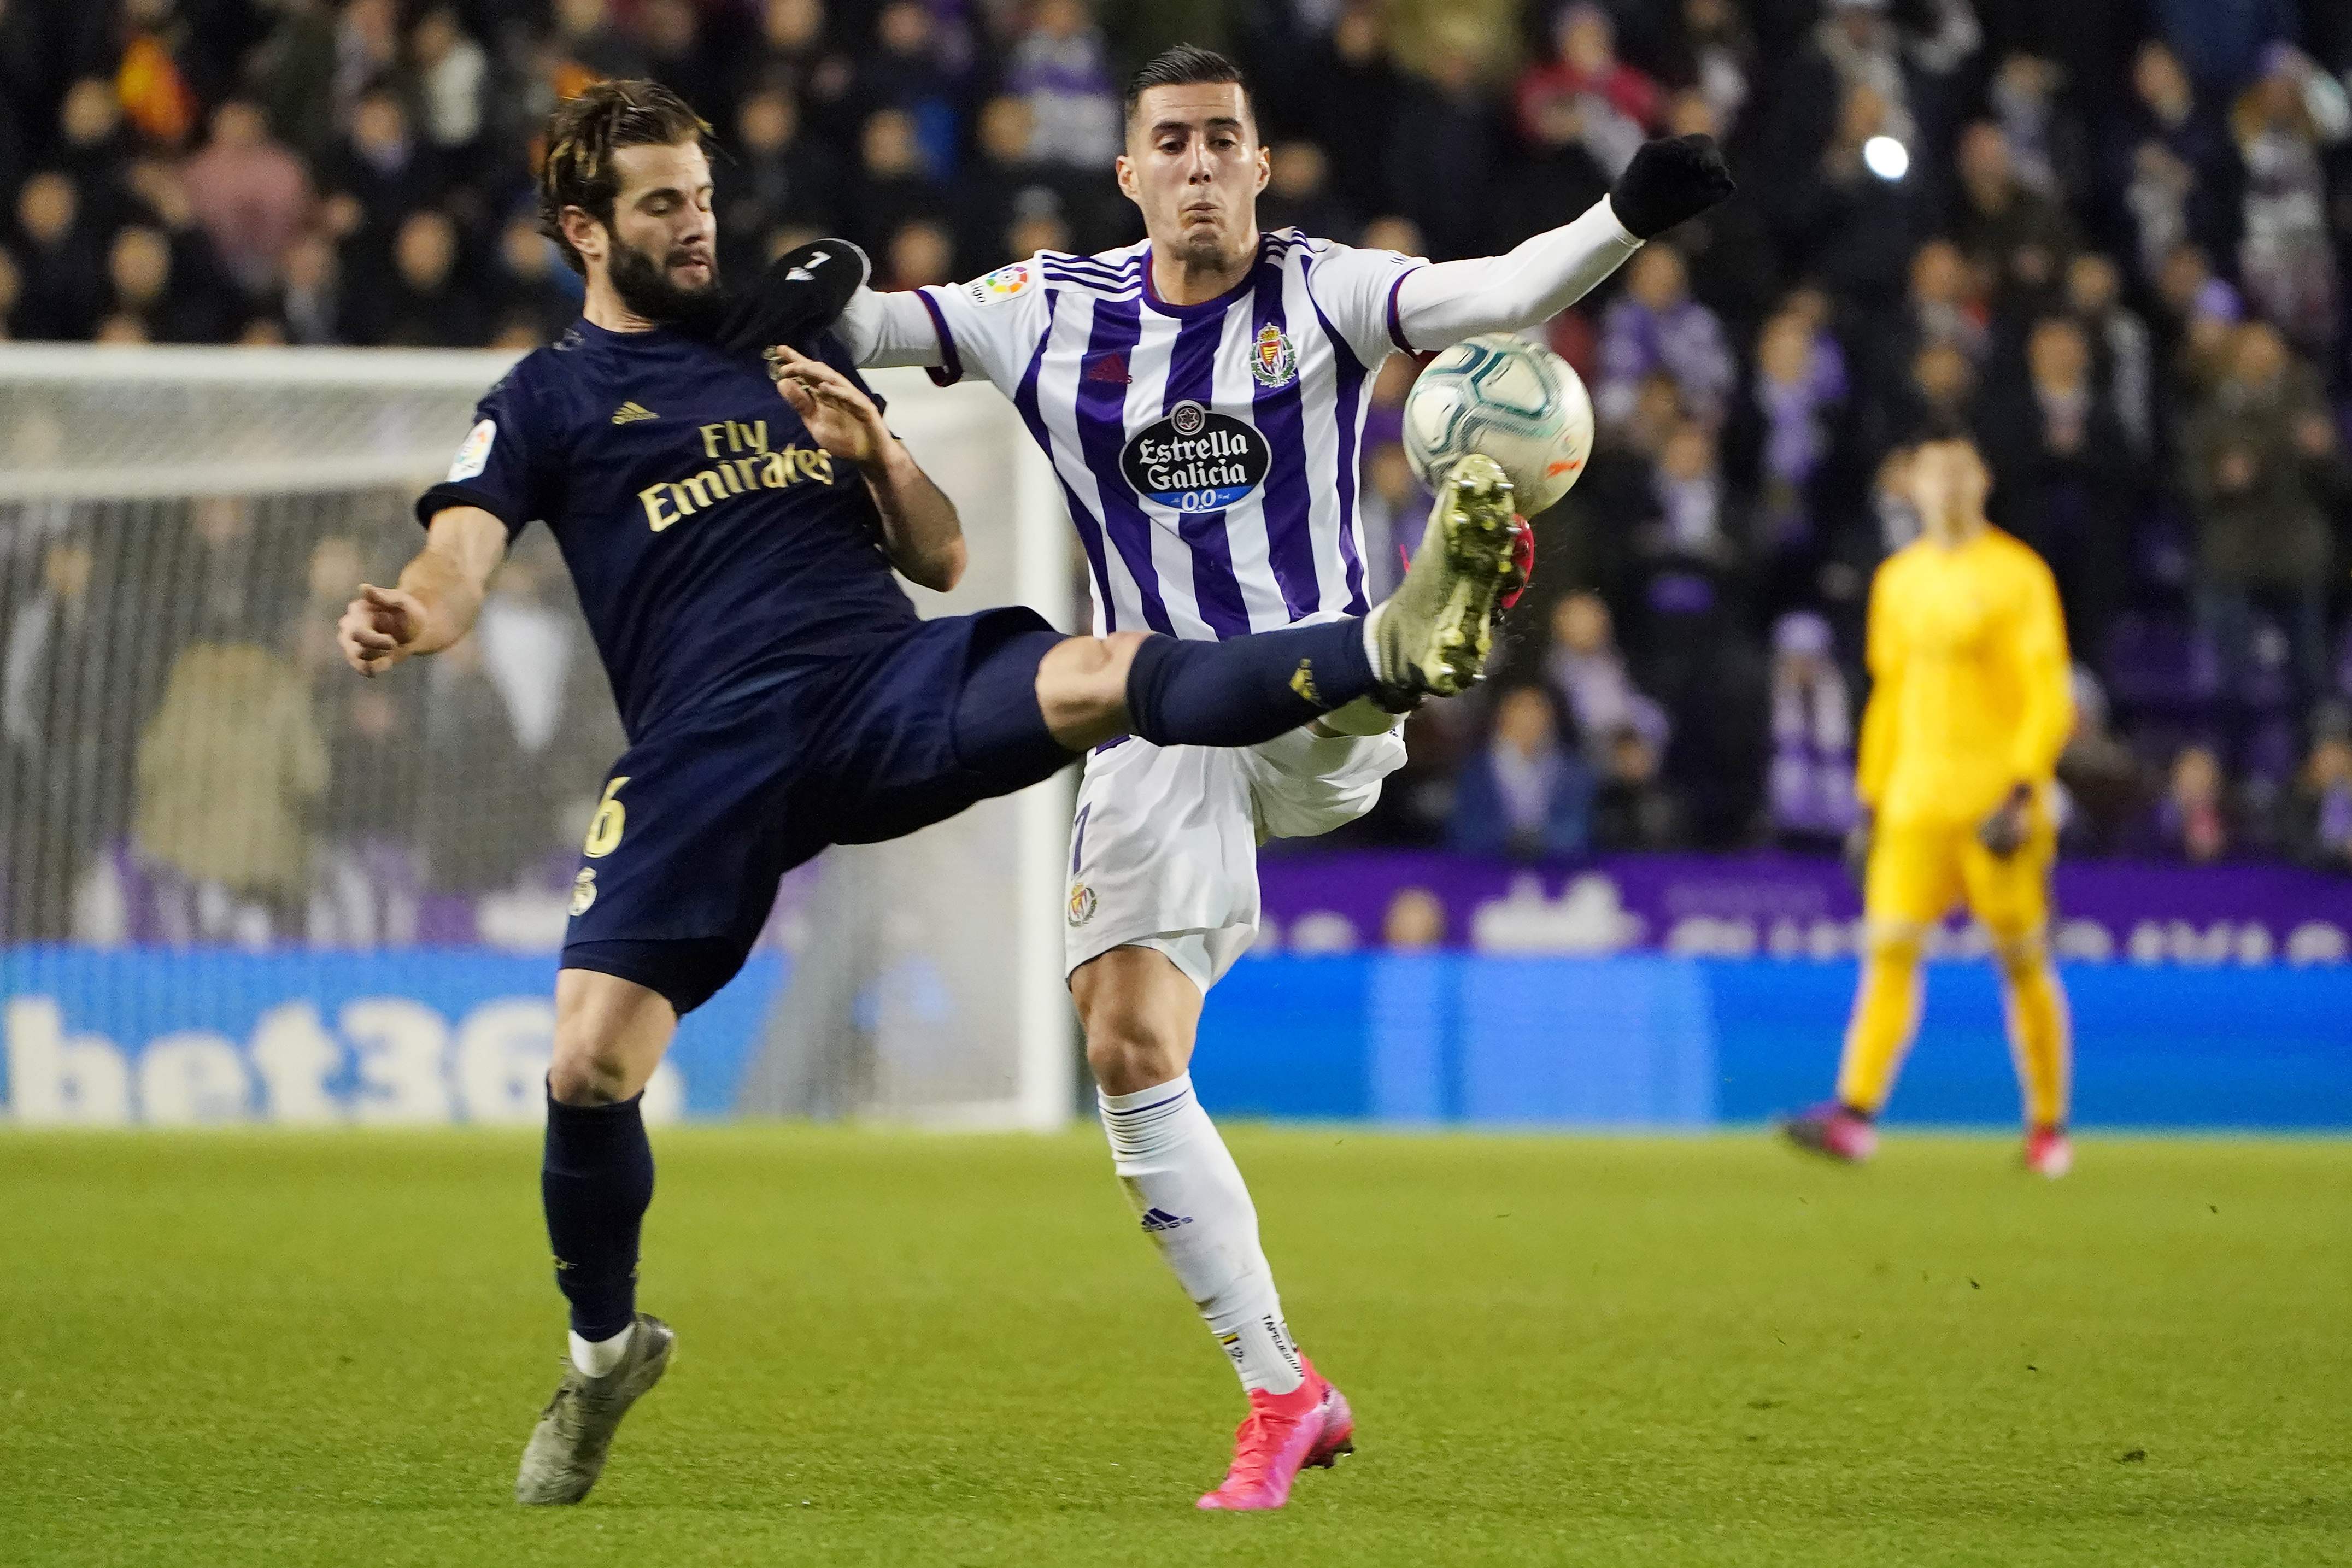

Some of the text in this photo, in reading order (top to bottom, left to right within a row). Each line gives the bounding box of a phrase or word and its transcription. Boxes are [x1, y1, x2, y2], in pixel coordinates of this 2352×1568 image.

[699, 420, 768, 458] Fly
[1139, 430, 1250, 465] Estrella
[1148, 459, 1248, 490] Galicia
[637, 443, 834, 532] Emirates
[583, 776, 632, 858] 6
[1074, 801, 1092, 875] 7
[8, 996, 687, 1126] bet36
